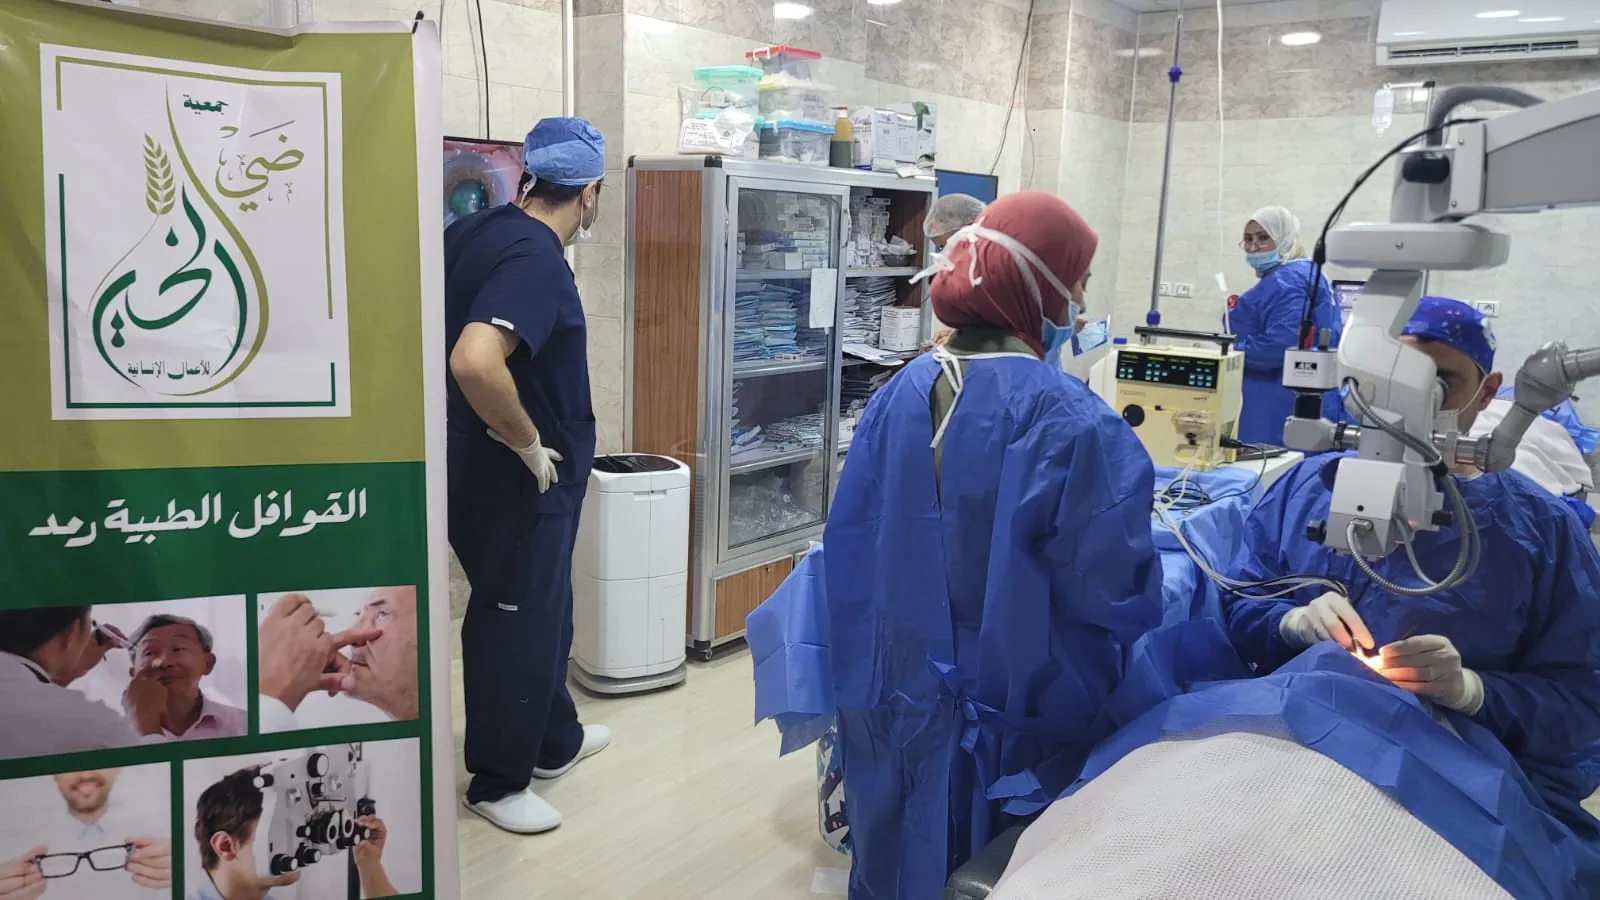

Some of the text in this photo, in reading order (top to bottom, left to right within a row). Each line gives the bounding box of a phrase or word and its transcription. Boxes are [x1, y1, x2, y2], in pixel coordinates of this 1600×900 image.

[182, 93, 229, 116] جمعية
[28, 487, 366, 548] القوافل الطبية رمد
